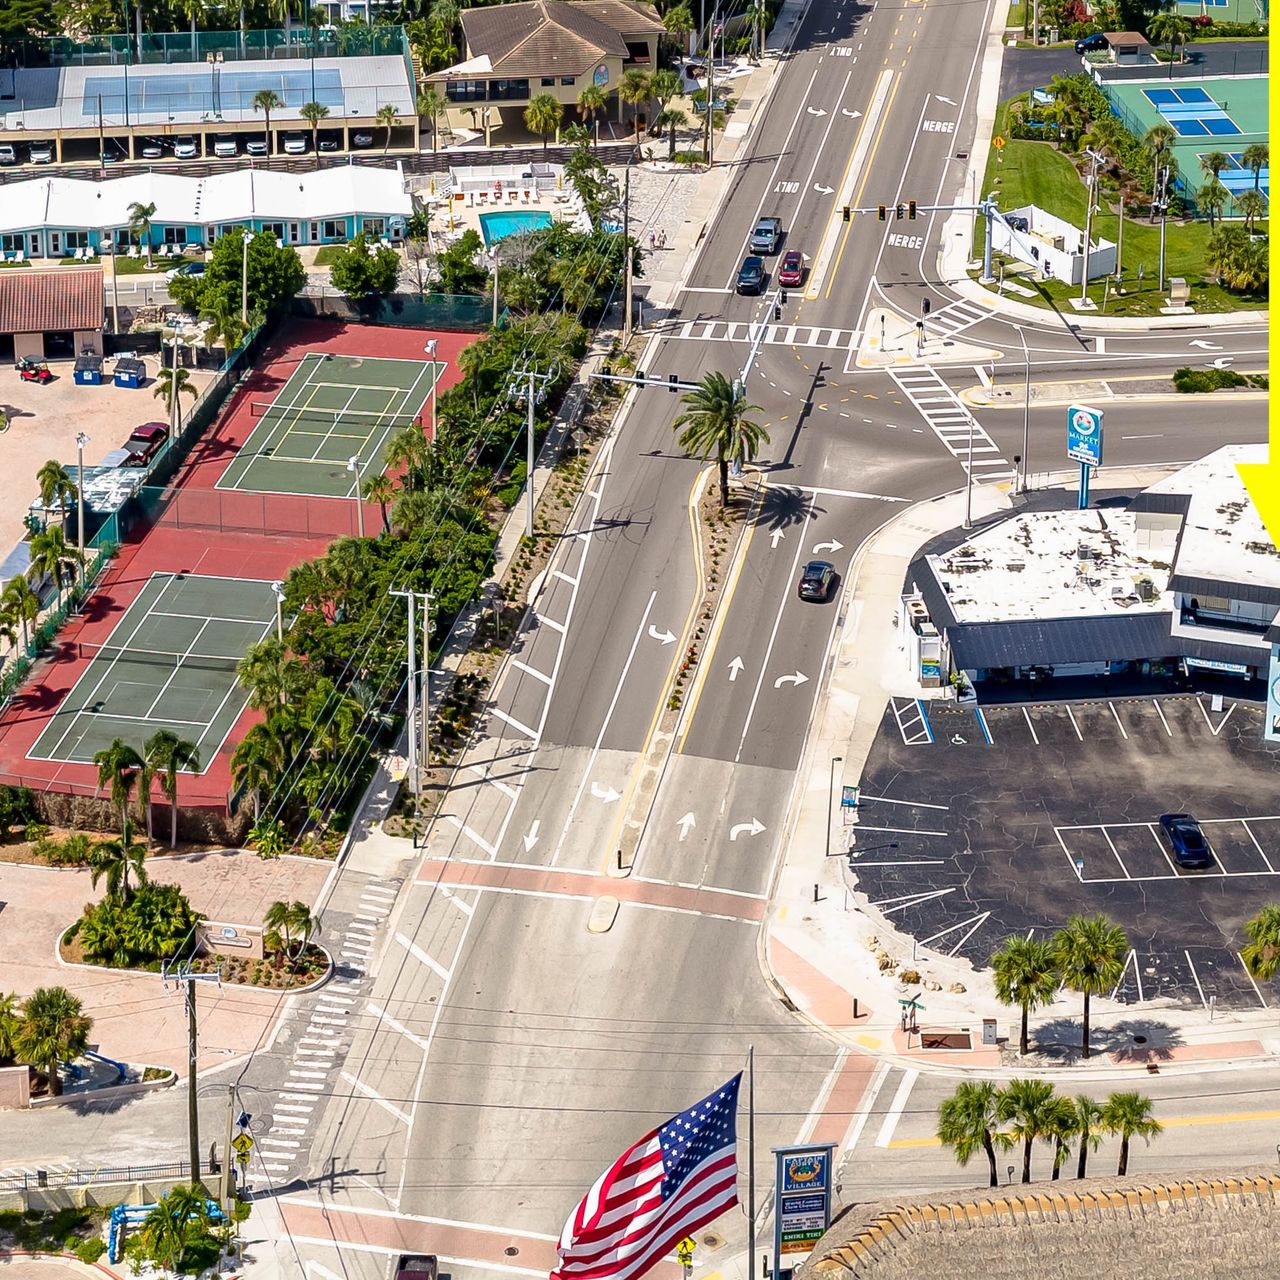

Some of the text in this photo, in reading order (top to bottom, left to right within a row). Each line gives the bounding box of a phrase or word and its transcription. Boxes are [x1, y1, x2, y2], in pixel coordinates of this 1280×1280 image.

[829, 46, 853, 57] ONLY
[922, 119, 955, 134] MERGE
[773, 181, 800, 194] ONLY
[887, 233, 924, 250] MERGE
[1069, 431, 1099, 445] MARKET
[786, 1156, 823, 1164] CAPTAIN
[786, 1181, 822, 1189] VILLAGE
